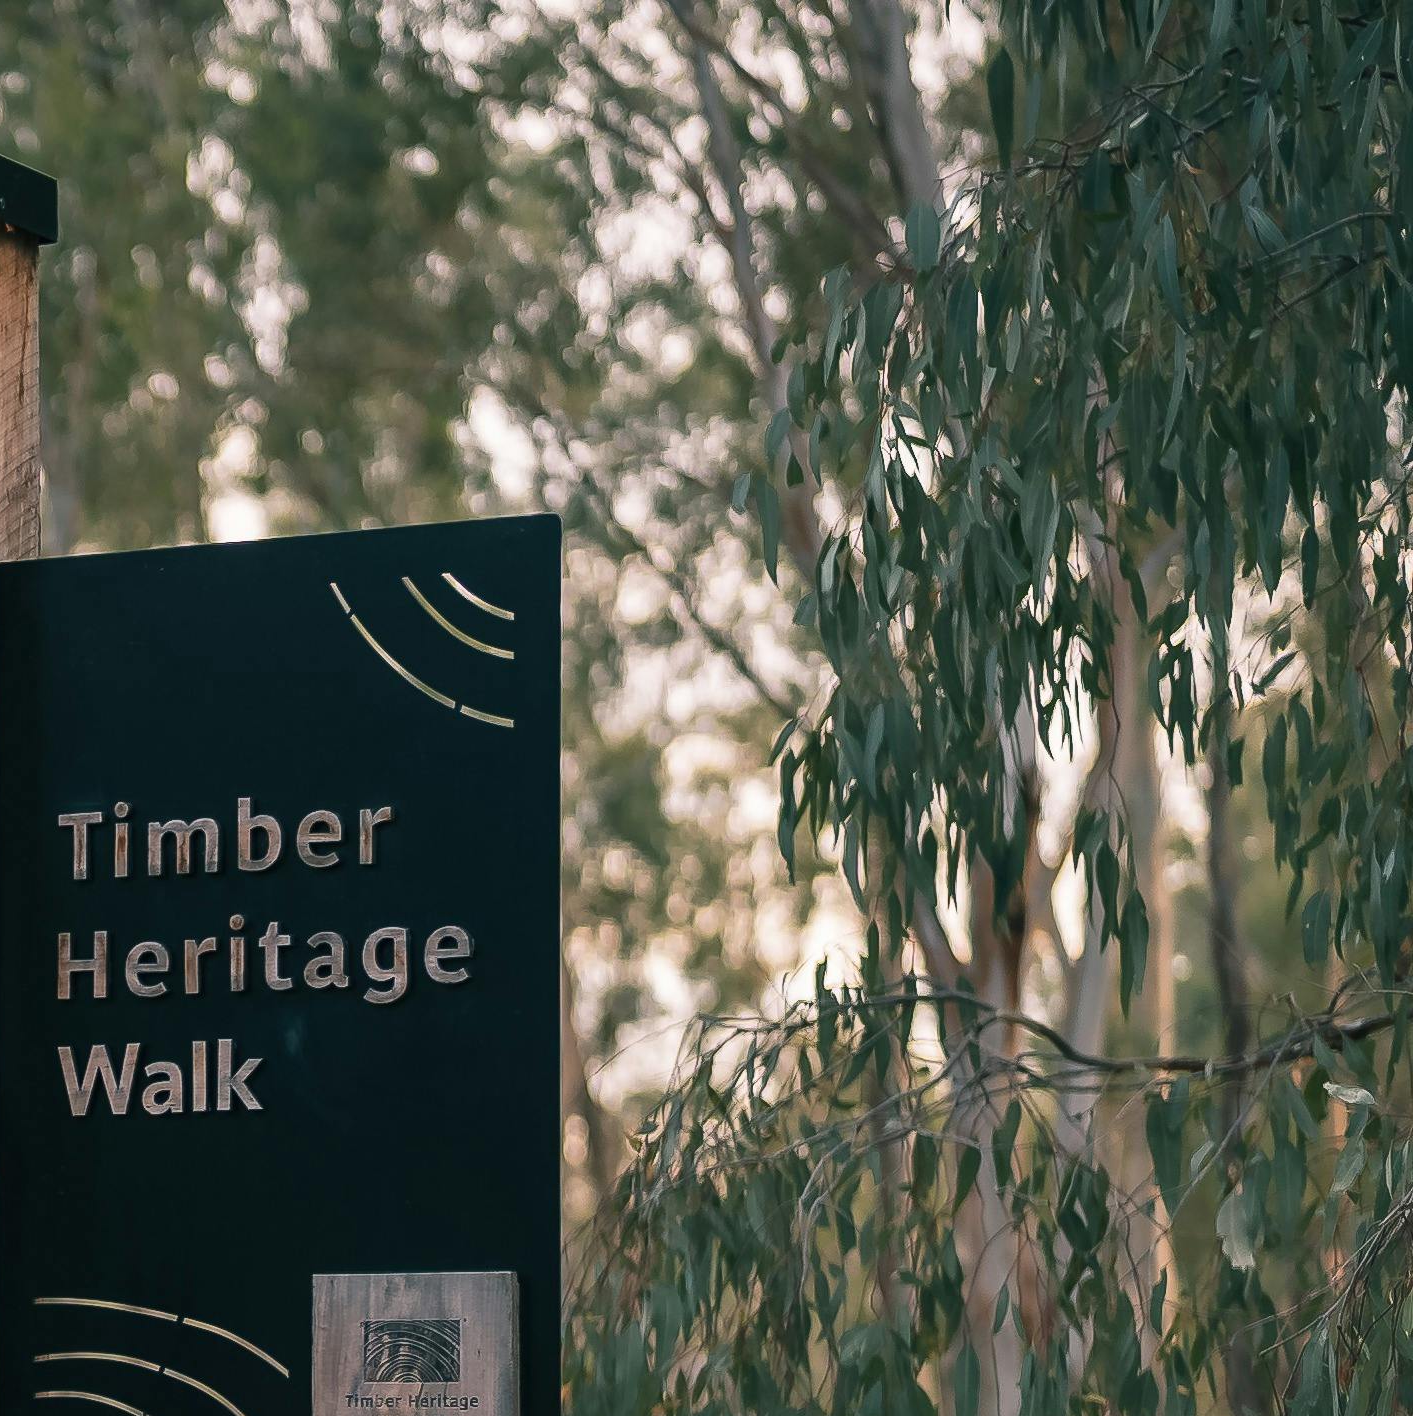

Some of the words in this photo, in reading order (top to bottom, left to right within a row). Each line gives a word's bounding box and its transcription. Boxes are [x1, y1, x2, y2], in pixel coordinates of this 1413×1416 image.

[58, 797, 394, 879] Timber
[57, 914, 472, 1003] Heritage
[57, 1038, 263, 1116] Walk
[345, 1394, 402, 1407] Timber
[408, 1394, 479, 1411] Heritage
